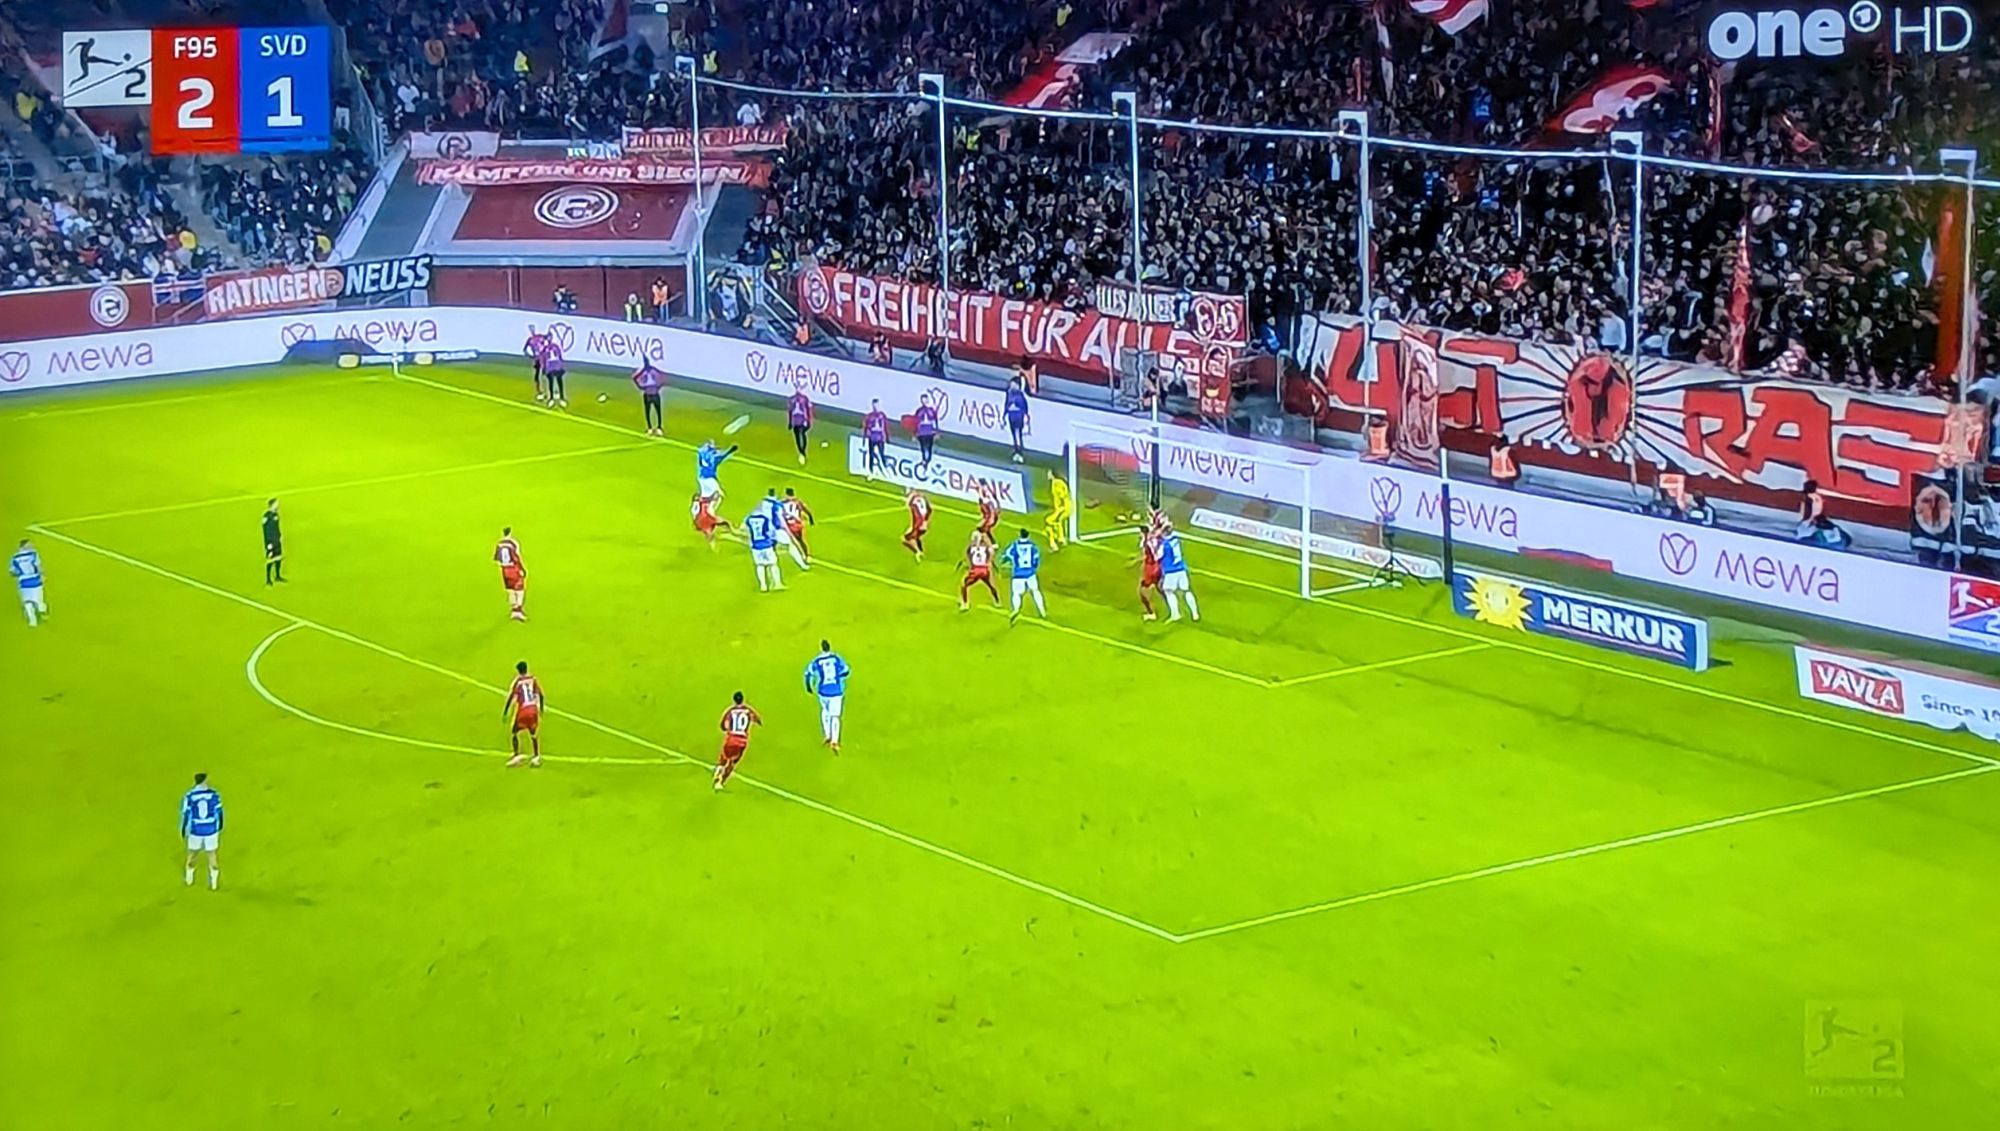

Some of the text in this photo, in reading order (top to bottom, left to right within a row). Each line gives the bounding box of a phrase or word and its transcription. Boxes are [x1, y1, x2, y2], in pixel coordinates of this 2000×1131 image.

[208, 257, 431, 314] RATINGEN NEUSS
[832, 272, 993, 345] FREIHEIT
[1002, 299, 1078, 358] FÜR
[1541, 594, 1687, 653] MERKUR
[1816, 664, 1899, 710] YAYLA
